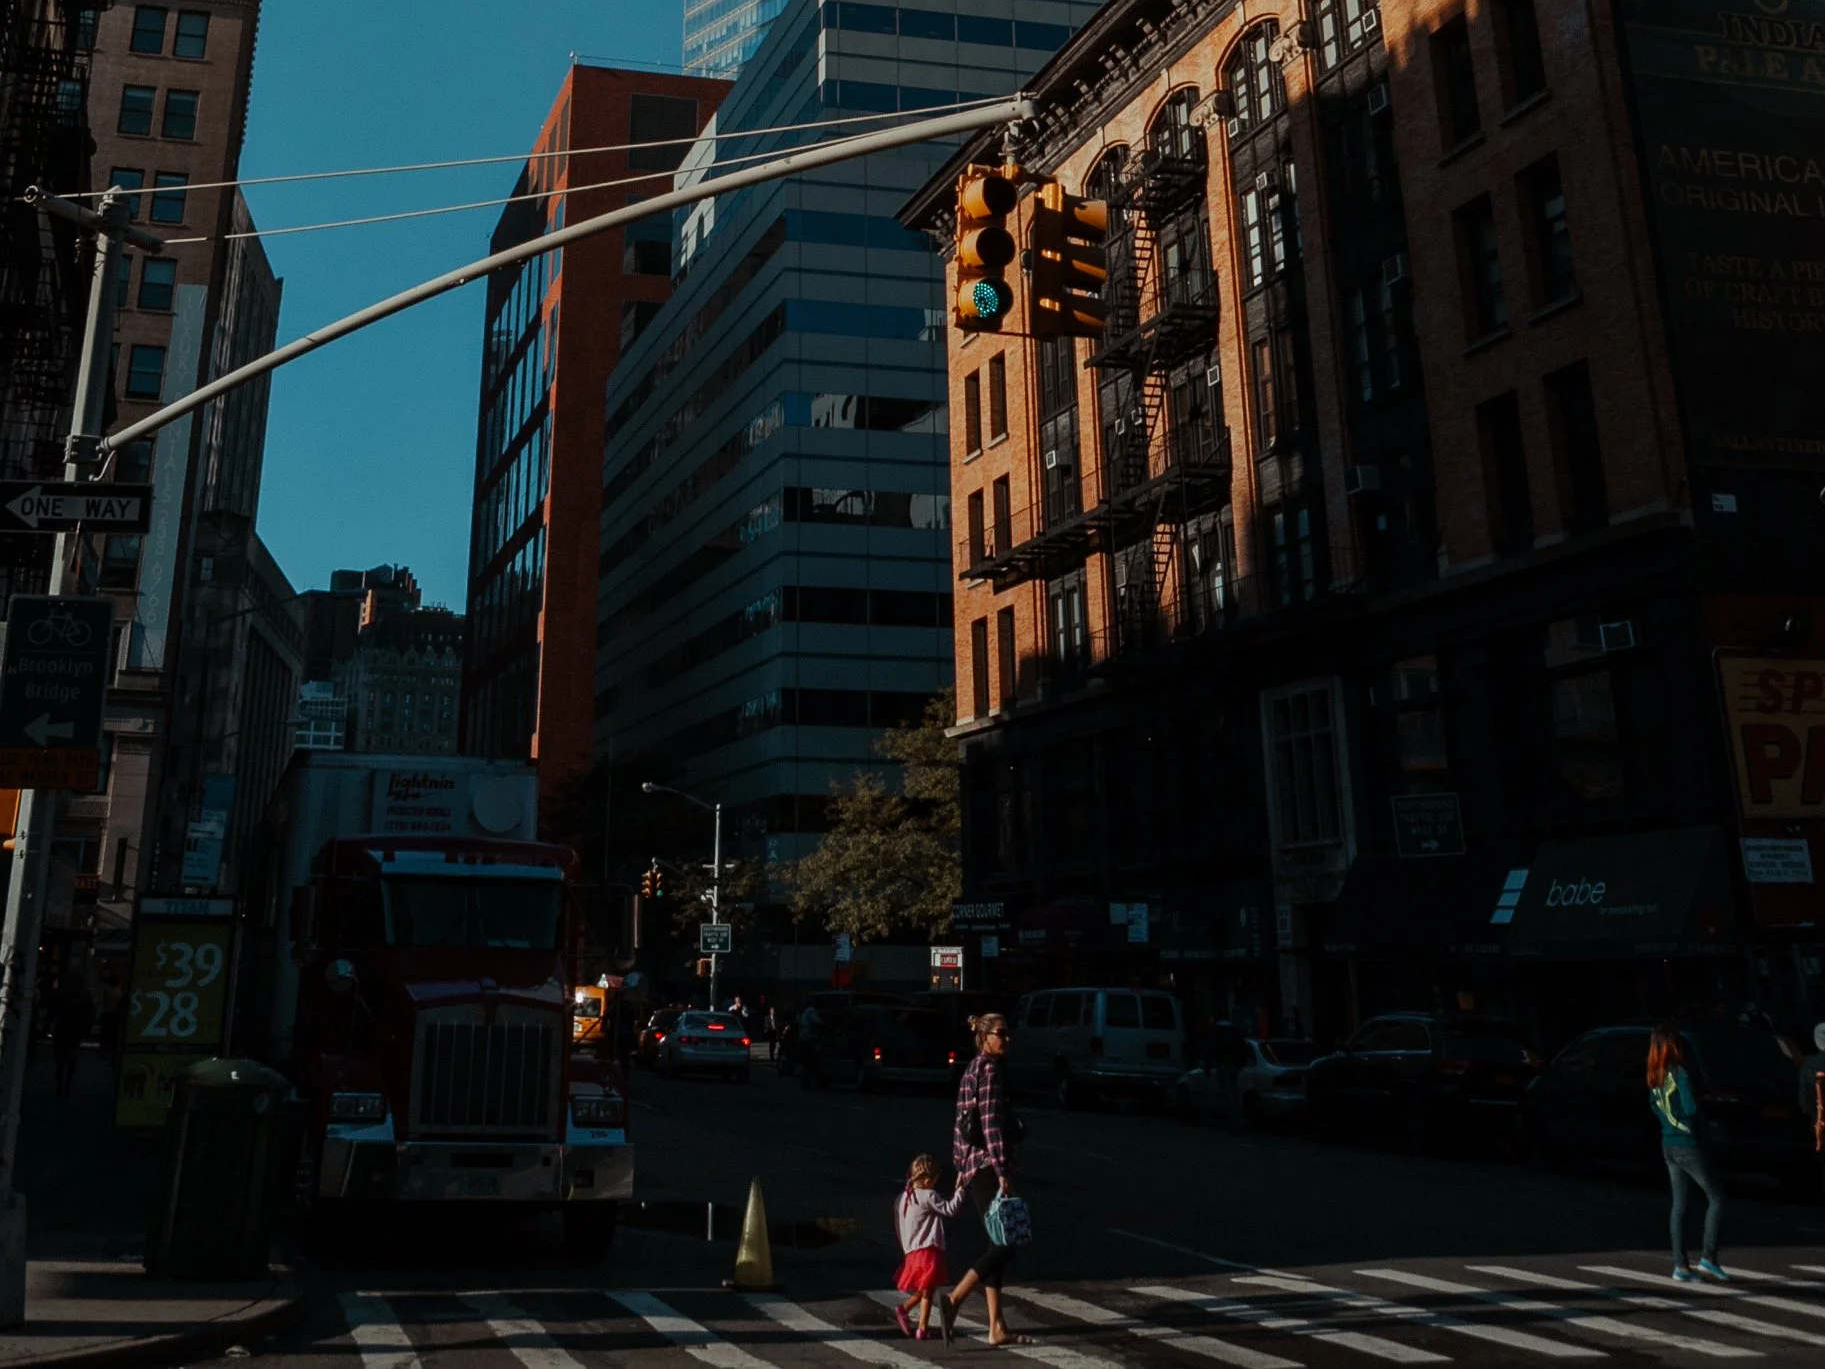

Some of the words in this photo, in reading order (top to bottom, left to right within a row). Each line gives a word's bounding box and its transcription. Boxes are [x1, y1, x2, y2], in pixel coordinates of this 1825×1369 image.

[1660, 182, 1813, 218] ORIGINAL
[1684, 250, 1763, 278] TASTE
[1768, 259, 1789, 280] A
[1684, 277, 1717, 300] OF
[1724, 282, 1801, 307] CRAFT
[21, 496, 64, 517] ONE
[85, 498, 132, 519] WAY
[18, 656, 94, 679] Brooklyn
[24, 681, 81, 704] Bridge
[1544, 876, 1608, 907] babe
[155, 939, 223, 988] $39
[129, 987, 199, 1039] $28
